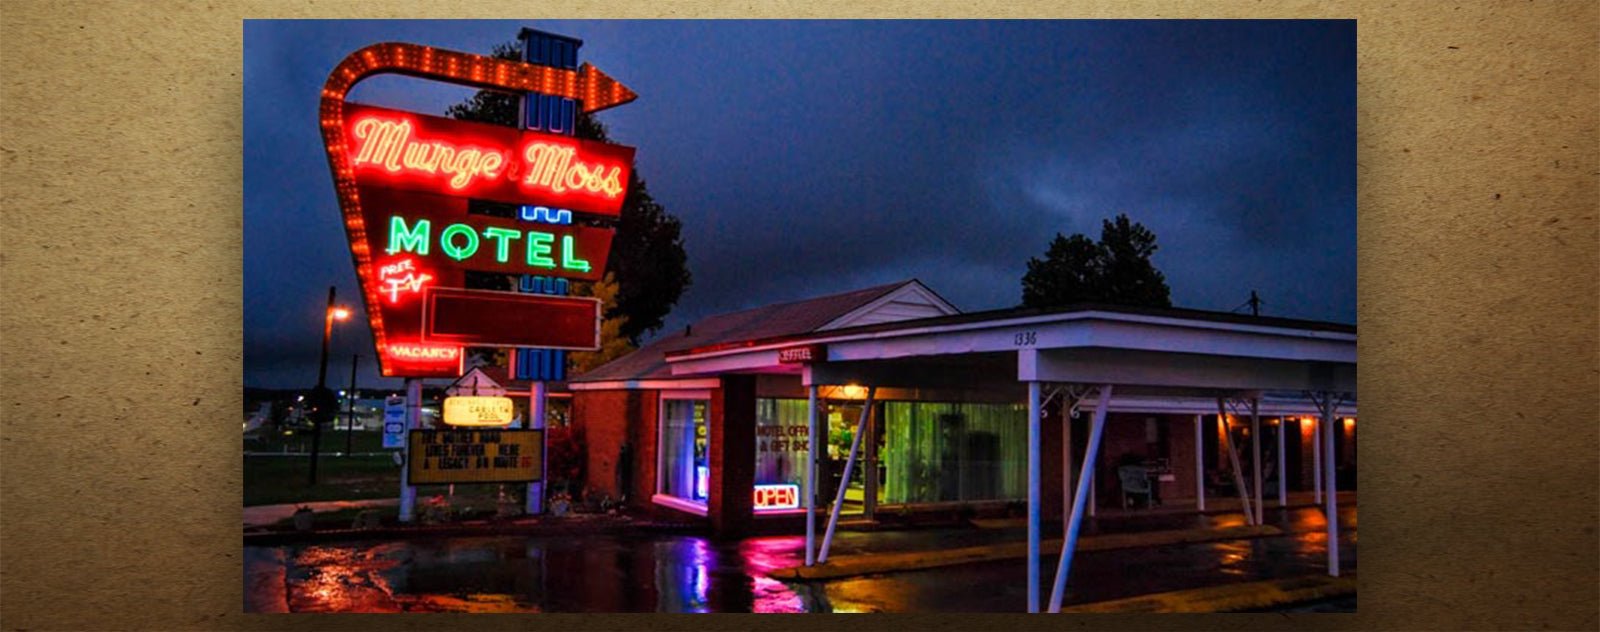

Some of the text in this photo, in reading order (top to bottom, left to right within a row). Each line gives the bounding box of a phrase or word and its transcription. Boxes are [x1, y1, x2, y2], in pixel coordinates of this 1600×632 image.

[524, 143, 624, 198] Moss
[386, 216, 592, 273] MOTEL
[380, 258, 416, 281] FREE
[1014, 331, 1037, 346] 1336
[390, 346, 458, 360] VACANCY
[788, 425, 809, 437] OFFI
[793, 441, 809, 452] SHO
[438, 457, 469, 469] LEGACY
[754, 488, 795, 505] OPEN
